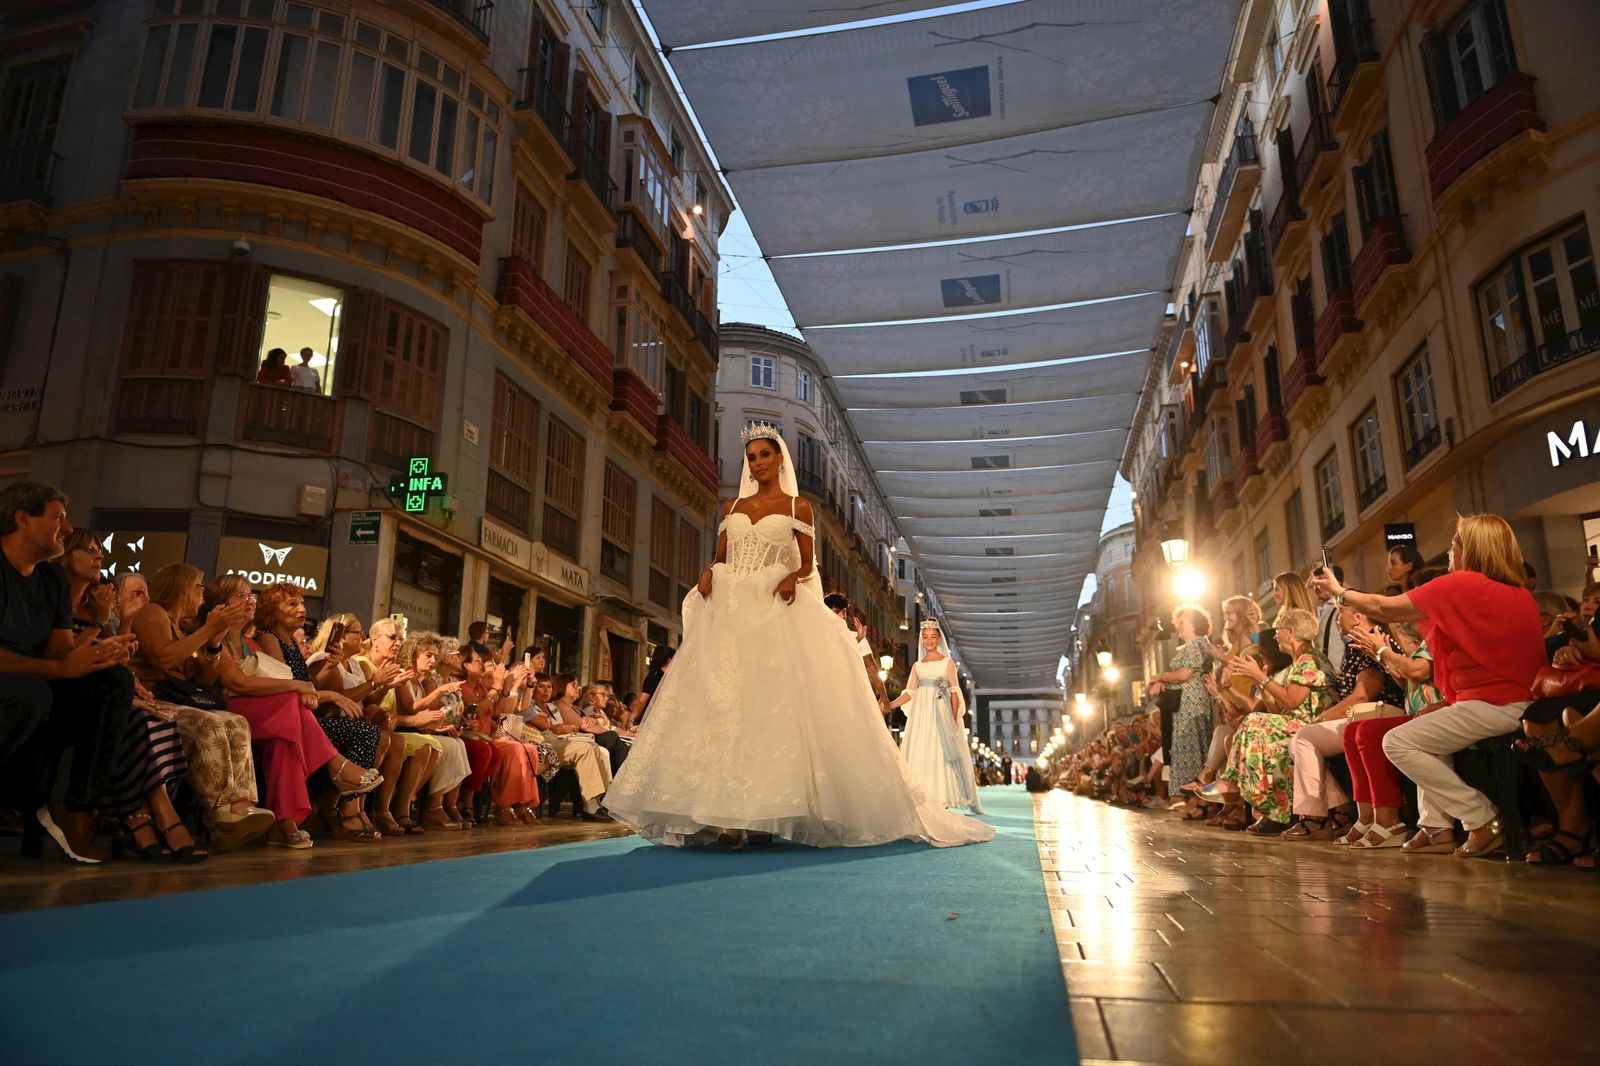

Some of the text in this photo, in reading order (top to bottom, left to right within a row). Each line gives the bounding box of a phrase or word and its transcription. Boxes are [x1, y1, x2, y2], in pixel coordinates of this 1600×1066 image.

[1547, 420, 1600, 467] M
[409, 477, 443, 491] INFA
[484, 526, 584, 590] FARMACIA MATA
